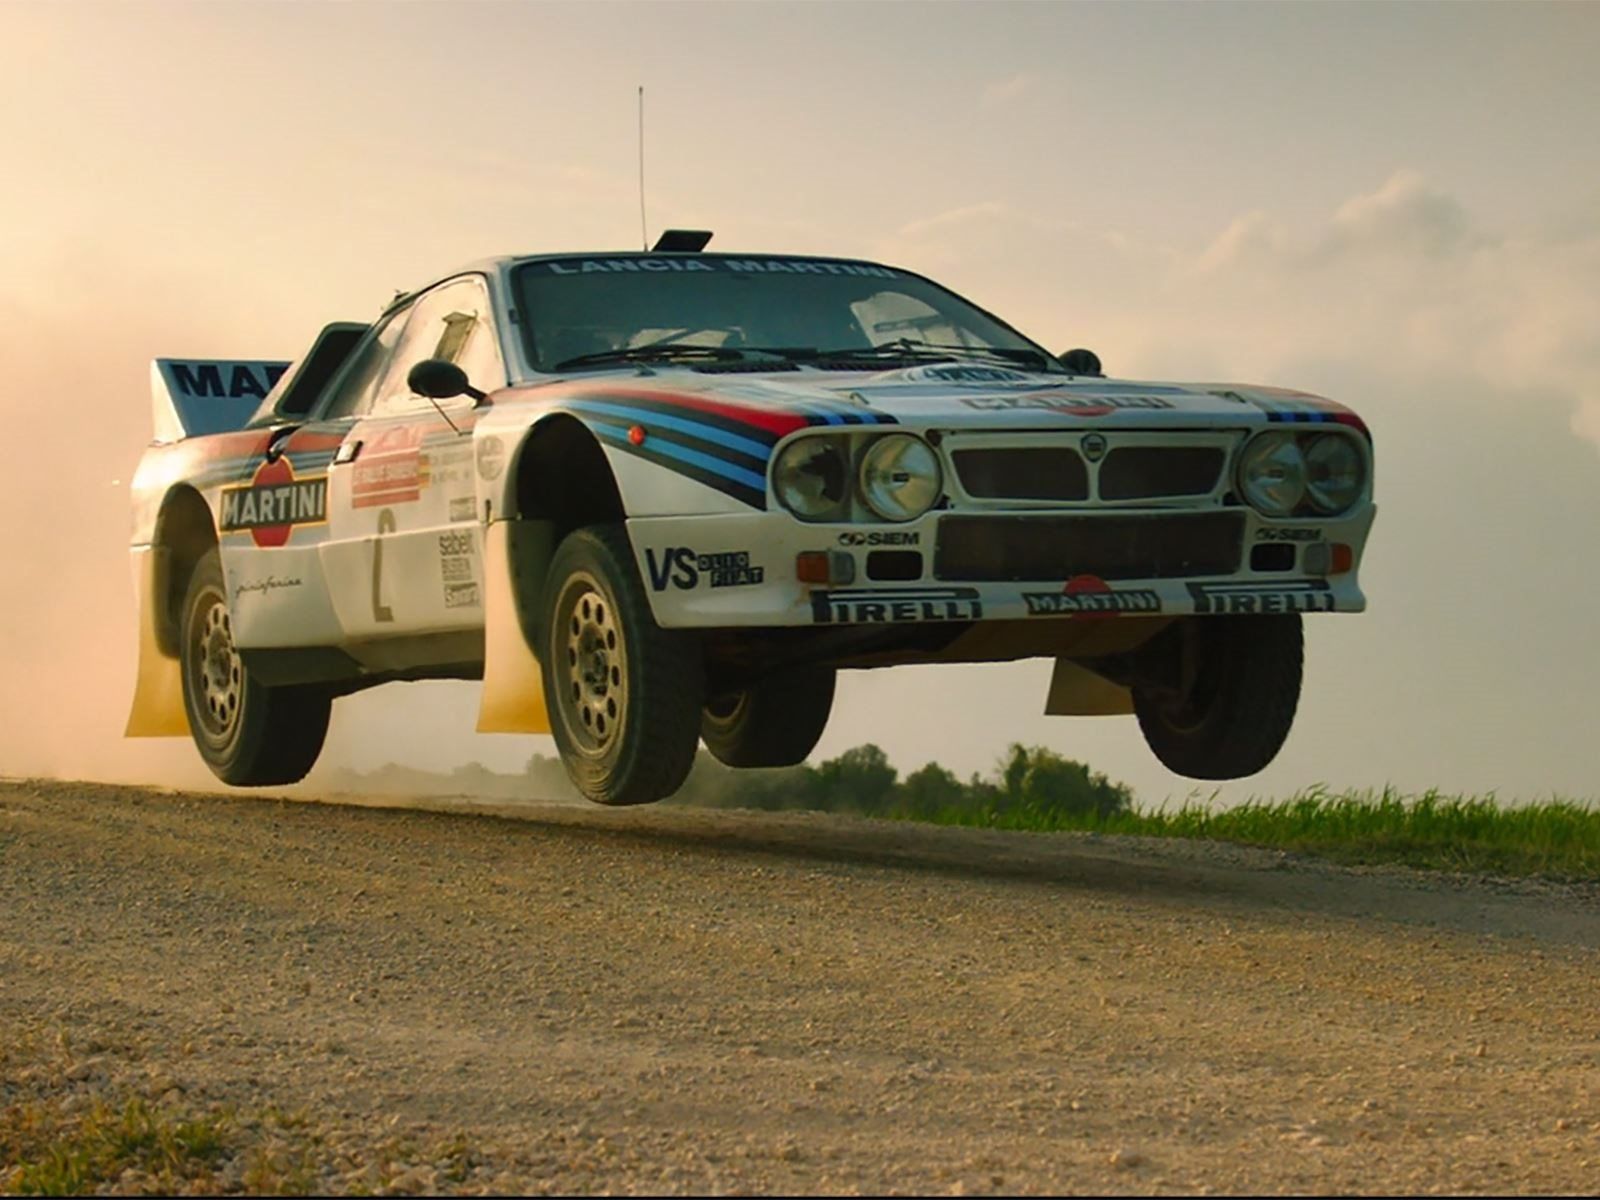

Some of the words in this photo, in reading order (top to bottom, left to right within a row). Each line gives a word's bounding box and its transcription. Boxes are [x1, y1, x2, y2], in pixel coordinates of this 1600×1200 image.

[548, 259, 714, 275] LANCIA
[725, 260, 897, 279] MARTINI
[221, 483, 326, 526] MARTINI
[867, 532, 919, 546] SIEM
[371, 507, 396, 622] 2
[645, 547, 698, 591] VS
[699, 552, 748, 571] OLIO
[711, 568, 763, 586] FIAT
[809, 587, 983, 624] PIRELLI
[1027, 591, 1158, 611] MARTINI
[1184, 578, 1336, 613] PIRELLI
